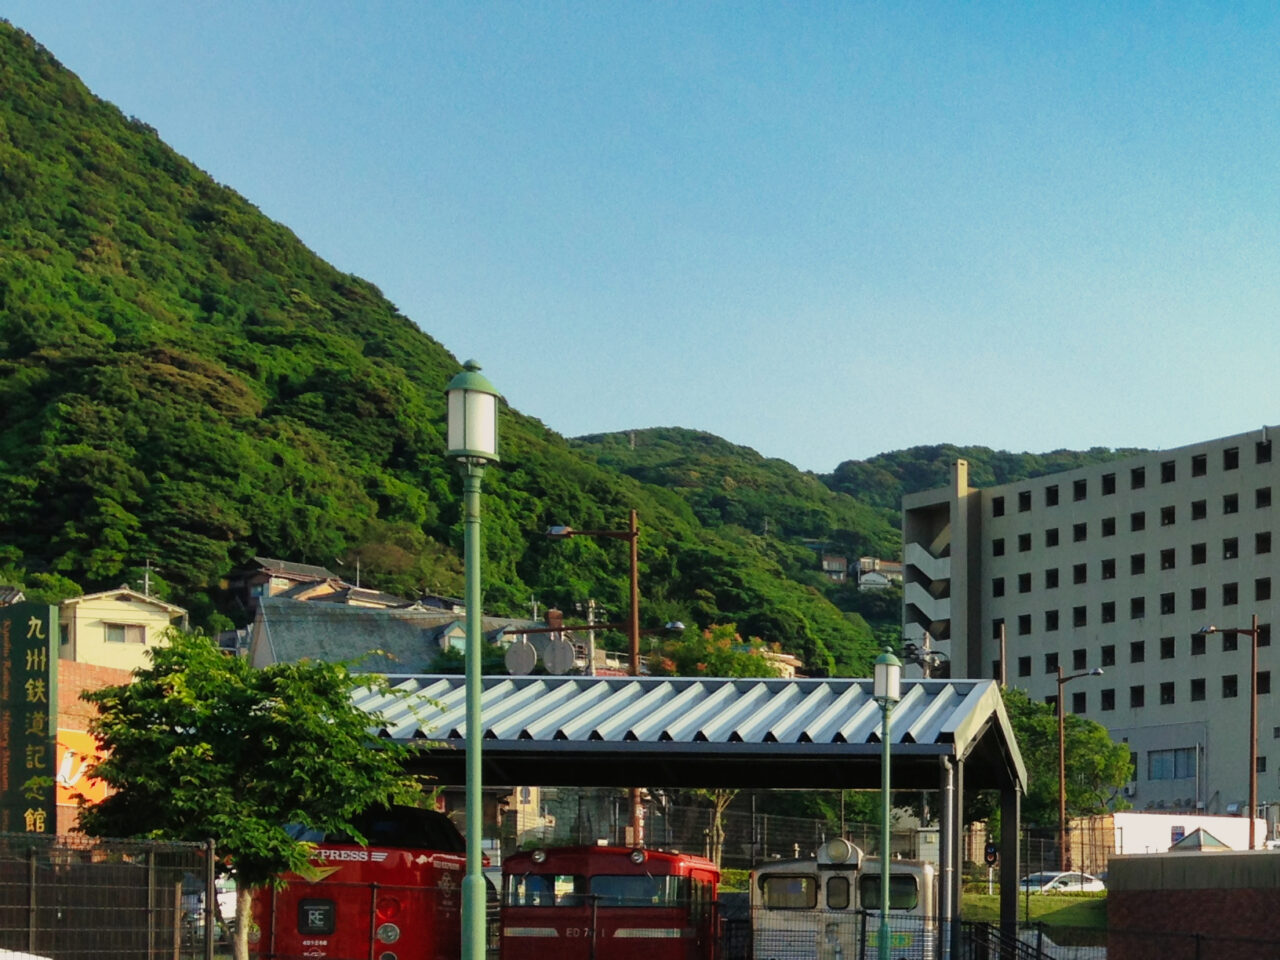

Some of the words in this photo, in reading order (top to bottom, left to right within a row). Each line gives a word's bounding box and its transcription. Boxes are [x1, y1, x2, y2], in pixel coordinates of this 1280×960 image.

[23, 615, 47, 833] 九州鉄道記念館
